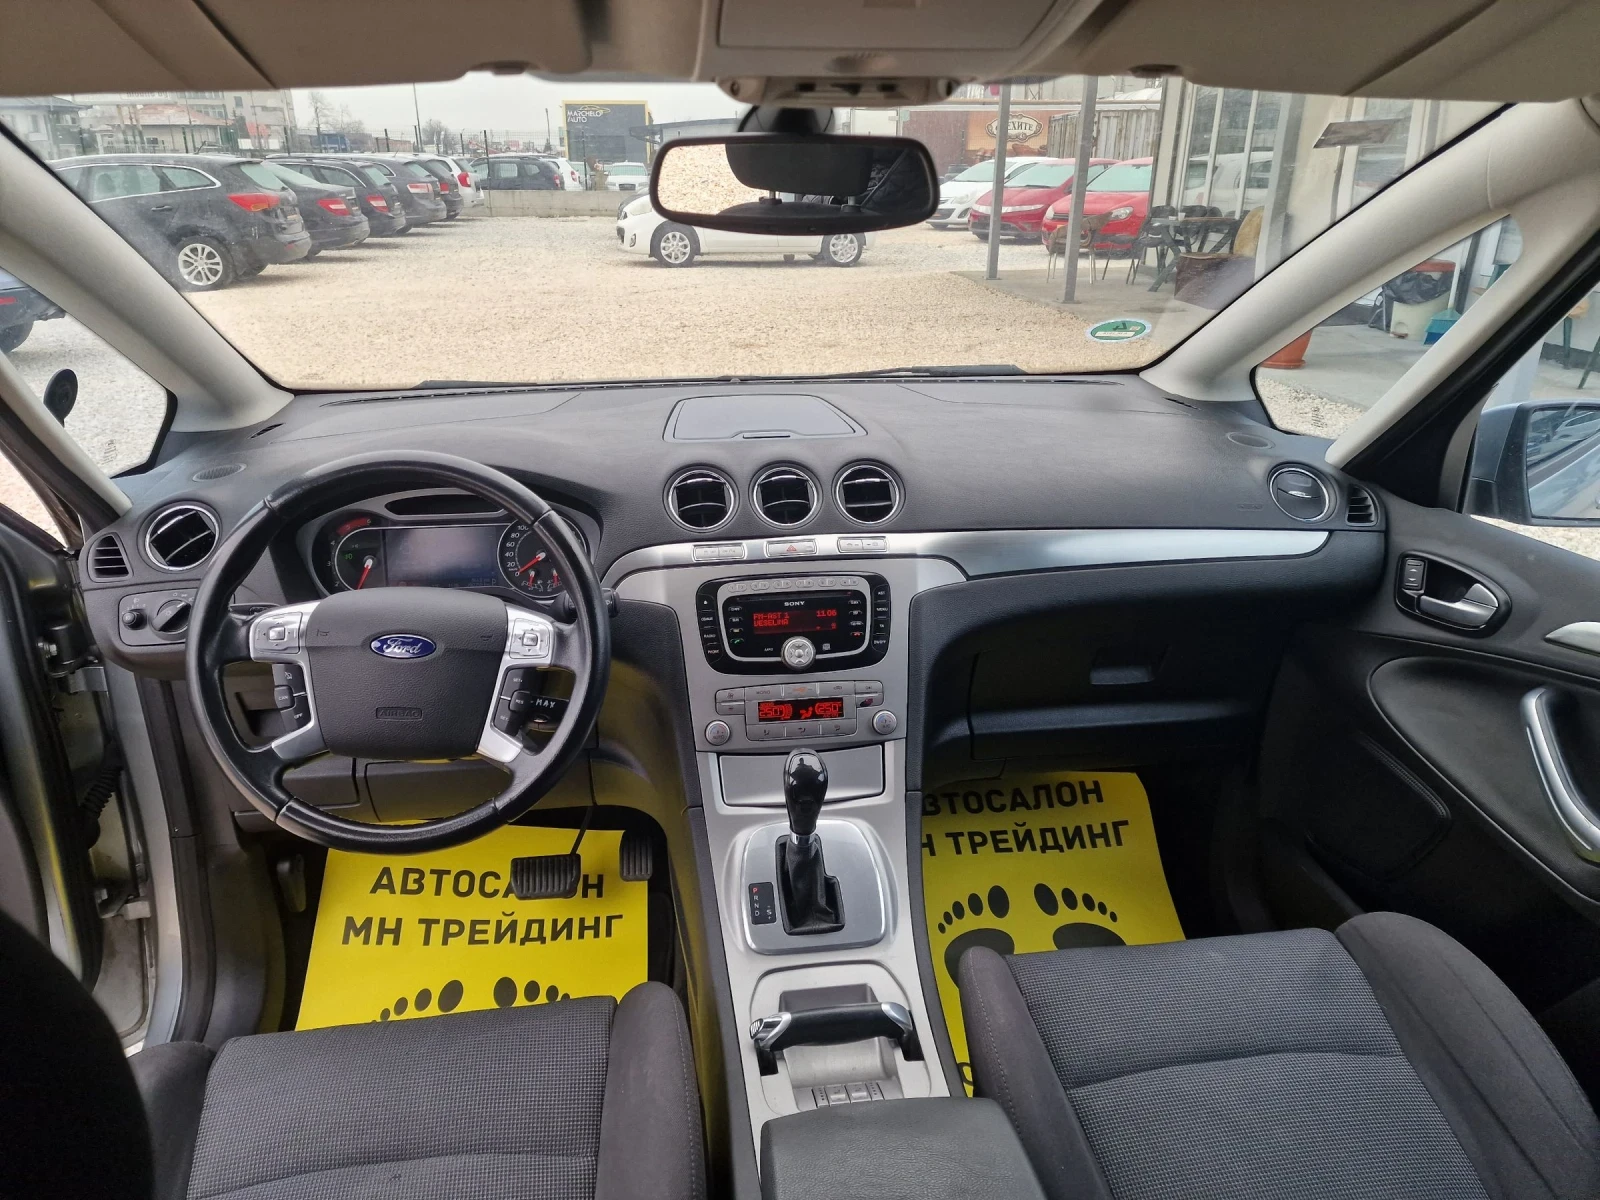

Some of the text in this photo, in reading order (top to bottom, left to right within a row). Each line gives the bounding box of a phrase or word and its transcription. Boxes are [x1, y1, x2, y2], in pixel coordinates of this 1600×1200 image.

[382, 637, 423, 654] Ford
[923, 779, 1105, 816] ВТОСАЛОН
[945, 820, 1130, 856] ТРЕЙДИНГ
[341, 911, 625, 946] МН ТРЕЙДИНГ
